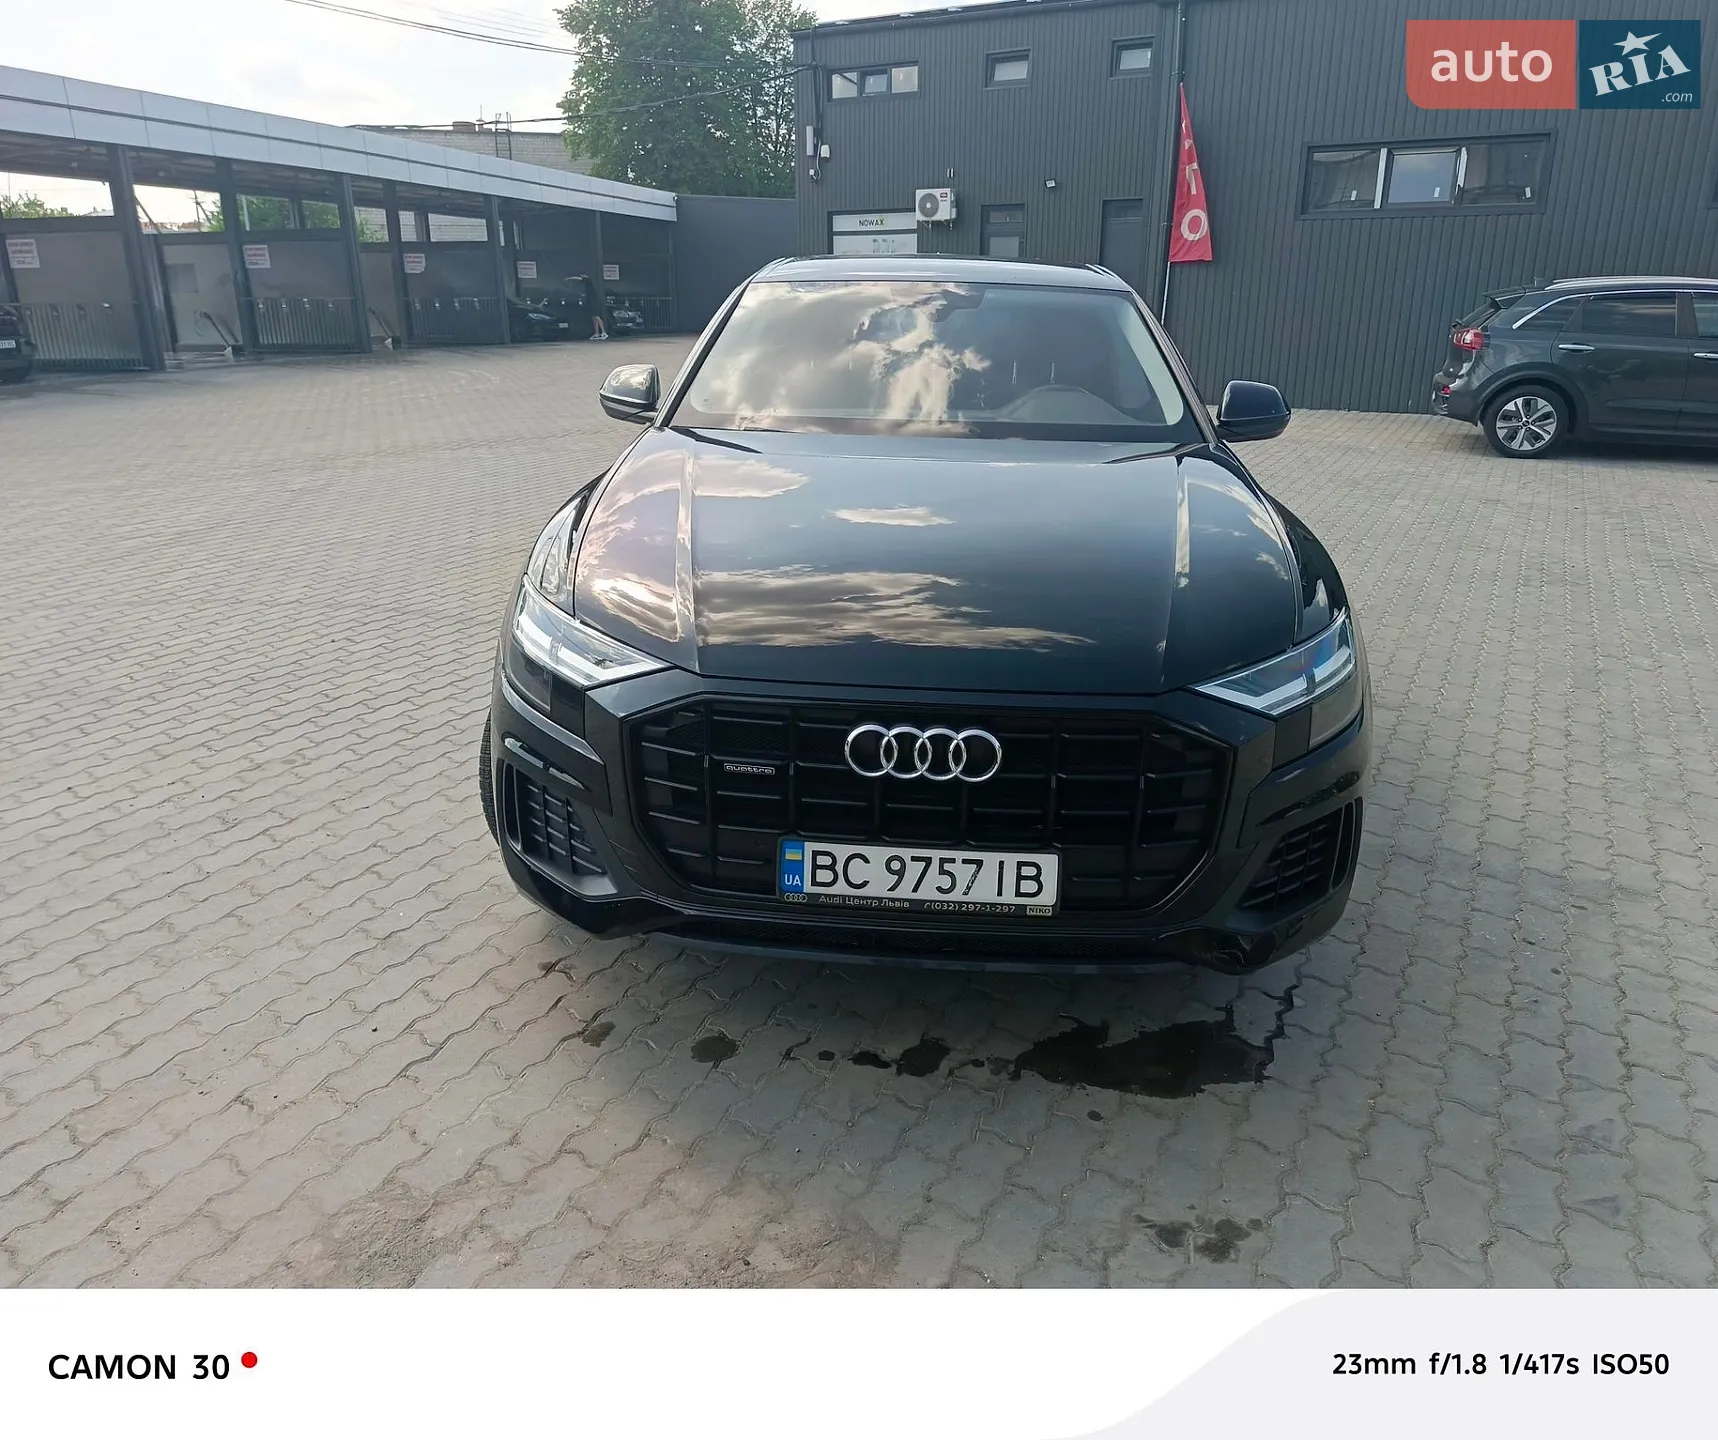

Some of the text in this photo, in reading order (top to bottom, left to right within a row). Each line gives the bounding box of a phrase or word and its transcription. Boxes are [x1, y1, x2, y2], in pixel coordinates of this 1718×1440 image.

[858, 218, 885, 227] NOWAX
[726, 765, 772, 774] quattro
[784, 873, 802, 886] UA
[810, 850, 1044, 898] BC 9757 IB
[820, 895, 1016, 913] Audi Центр Львів (032) 297-1-297
[1028, 906, 1051, 915] NIKO
